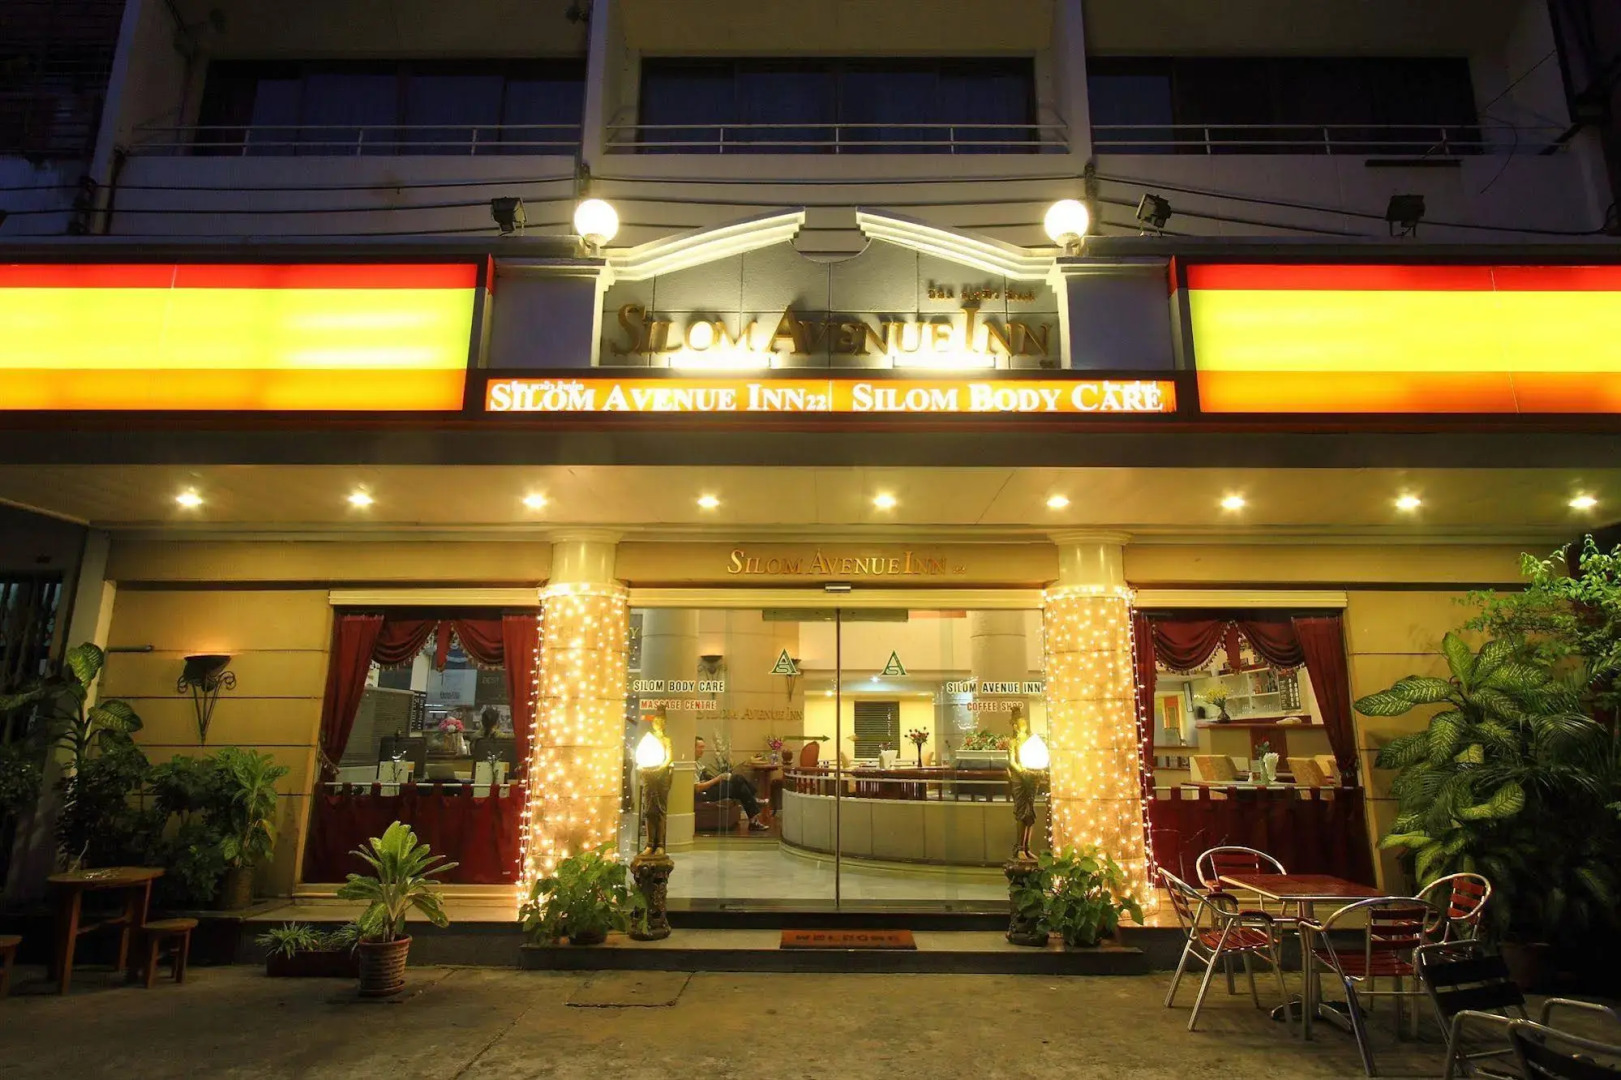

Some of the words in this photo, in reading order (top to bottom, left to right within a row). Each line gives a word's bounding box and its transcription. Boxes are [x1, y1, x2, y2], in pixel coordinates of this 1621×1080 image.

[612, 303, 757, 357] SILOM
[765, 303, 953, 356] AVENUE
[960, 306, 1053, 357] INN
[490, 384, 596, 411] SILOM
[603, 384, 737, 411] AVENUE
[852, 384, 958, 411] SILOM
[967, 384, 1062, 411] BODY
[1072, 384, 1163, 411] CARE
[727, 548, 802, 575] SILOM
[808, 548, 900, 575] AVENUE
[903, 550, 947, 575] INN
[634, 680, 664, 691] SILOM
[669, 681, 695, 692] BODY
[699, 681, 724, 692] CARE
[947, 682, 977, 693] SILOM
[982, 682, 1019, 693] AVENUE
[1023, 682, 1041, 694] INN
[685, 700, 716, 710] CENTRE
[967, 702, 997, 711] COFFEE
